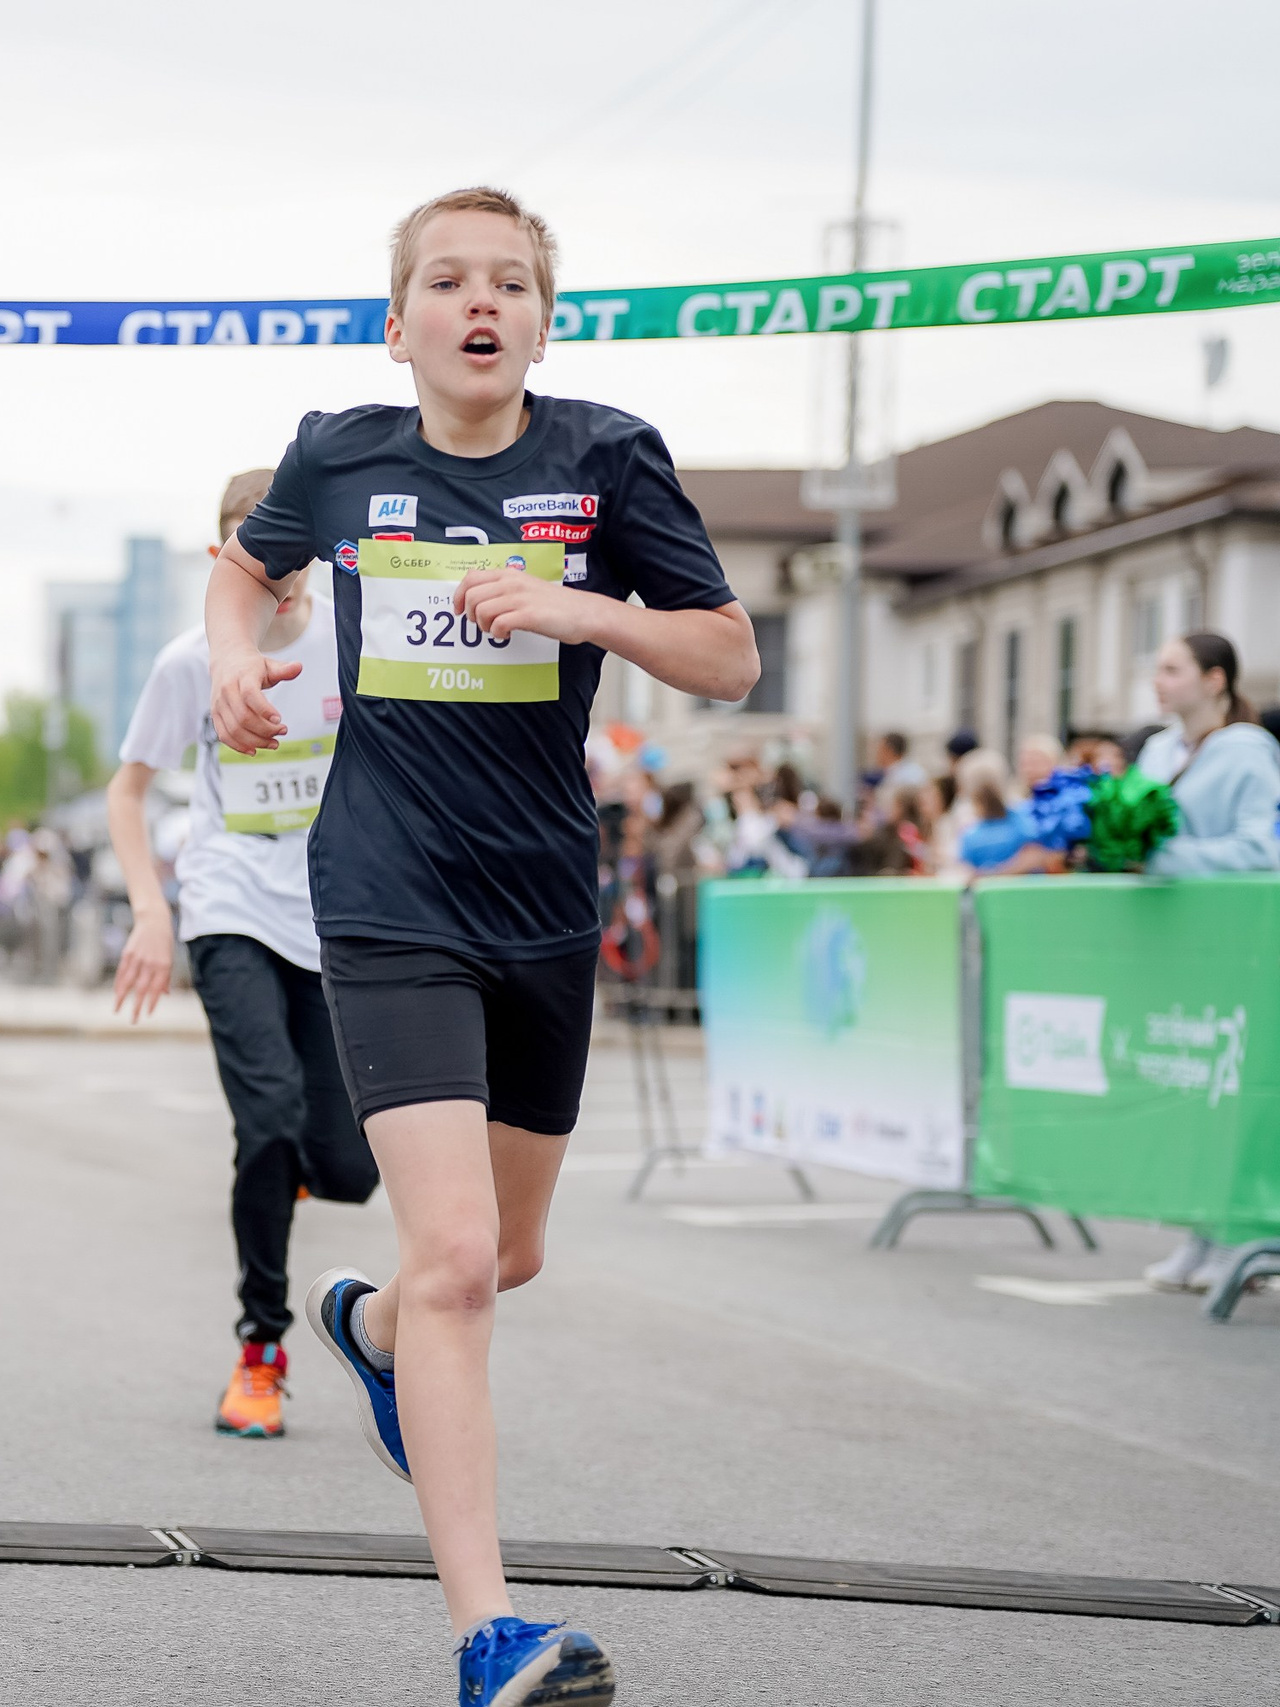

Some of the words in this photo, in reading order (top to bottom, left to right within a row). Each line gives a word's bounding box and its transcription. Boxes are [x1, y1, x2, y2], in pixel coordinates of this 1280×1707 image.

[956, 253, 1196, 323] СТАРТ
[676, 279, 912, 337] СТАРТ
[508, 499, 579, 514] SpareBank
[527, 524, 589, 539] Grilstad
[403, 559, 431, 568] СБЕР
[428, 595, 454, 605] 10-1
[255, 775, 318, 804] 3118
